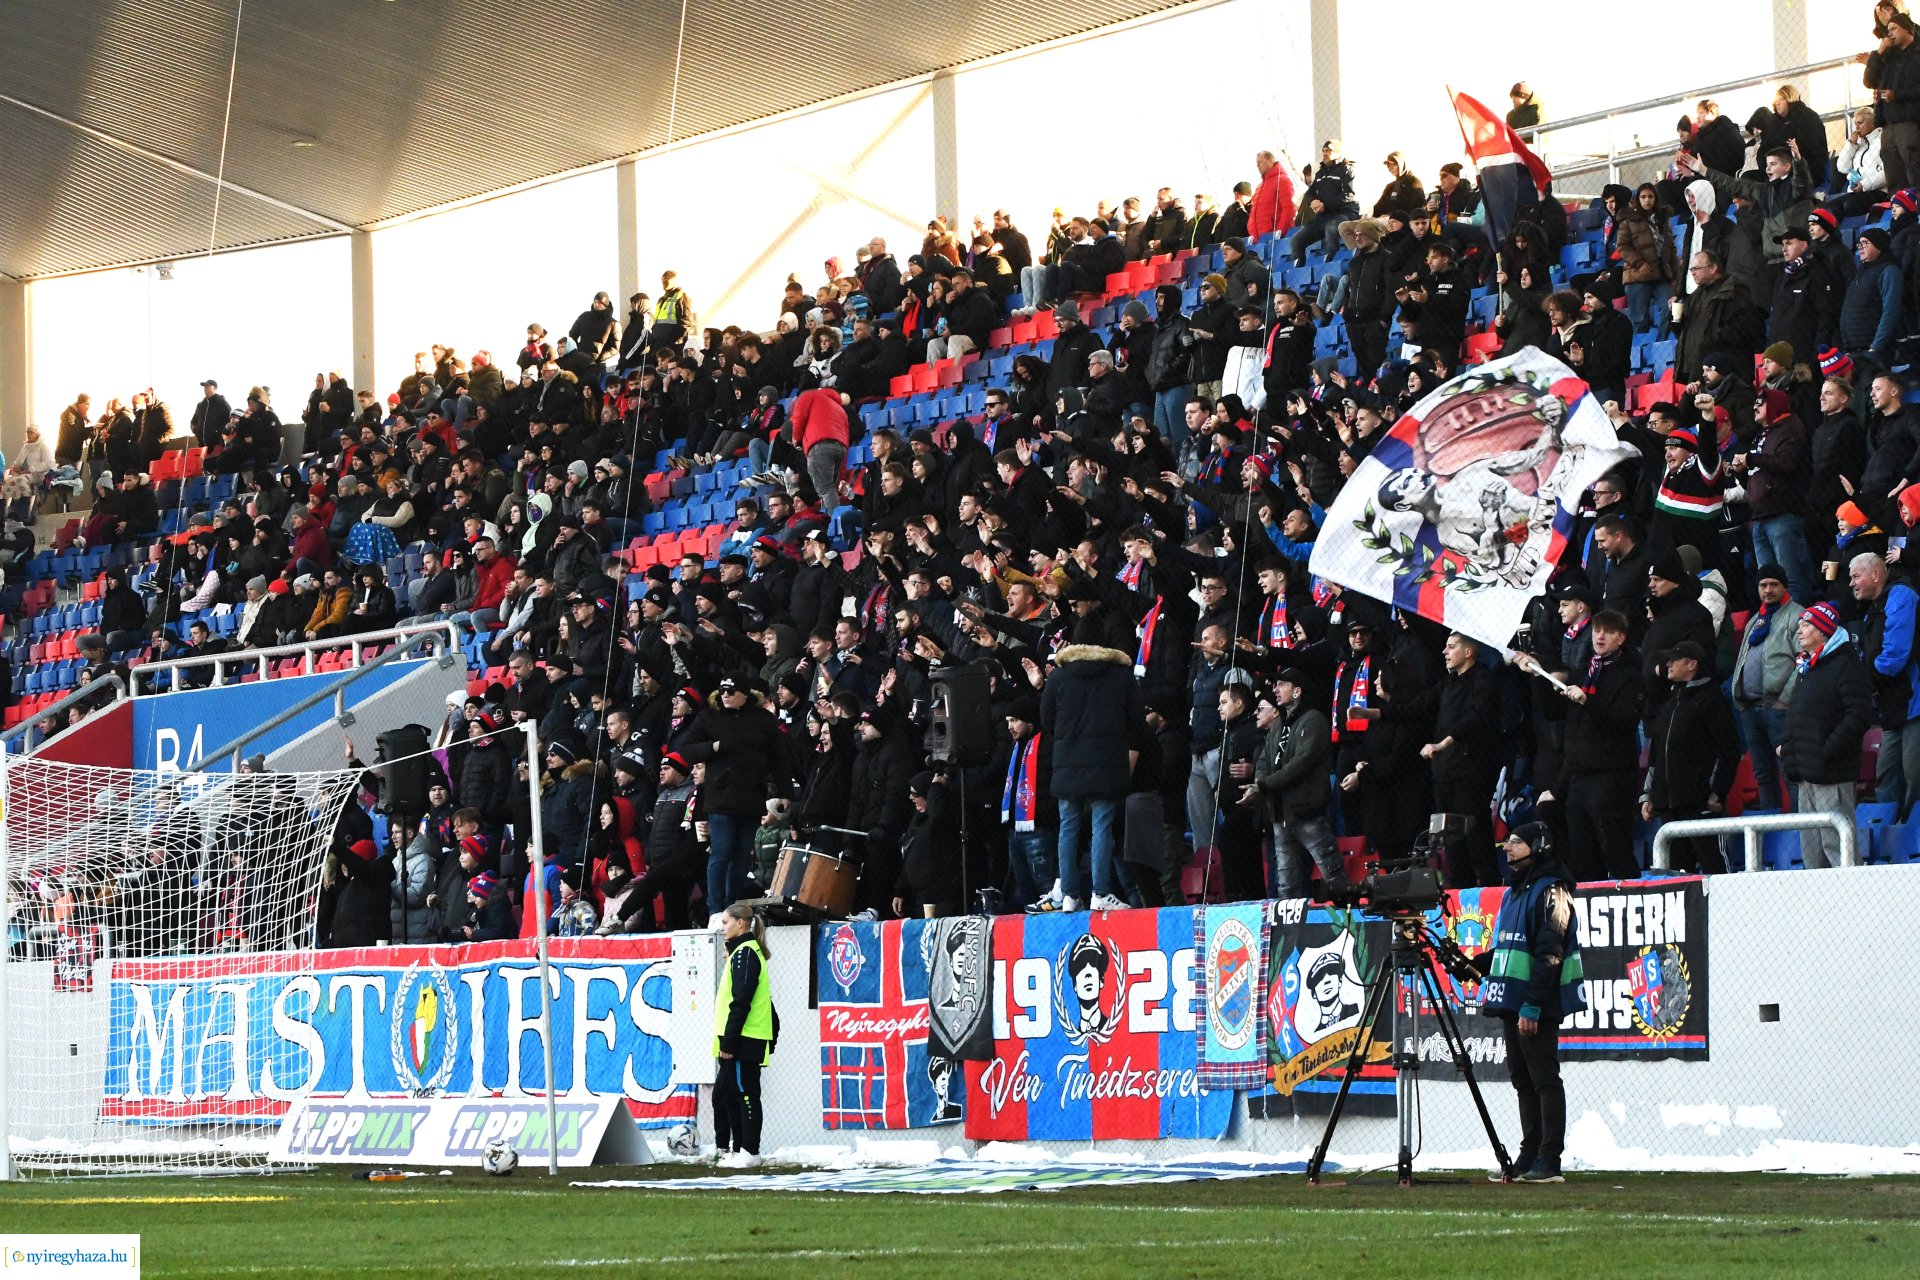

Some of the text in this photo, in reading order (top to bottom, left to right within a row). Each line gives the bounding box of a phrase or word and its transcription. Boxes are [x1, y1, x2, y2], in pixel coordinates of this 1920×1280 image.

[1574, 891, 1686, 948] ASTERN
[960, 918, 983, 1014] NYSFC
[1559, 979, 1632, 1030] OYS
[979, 1050, 1045, 1120] Vén
